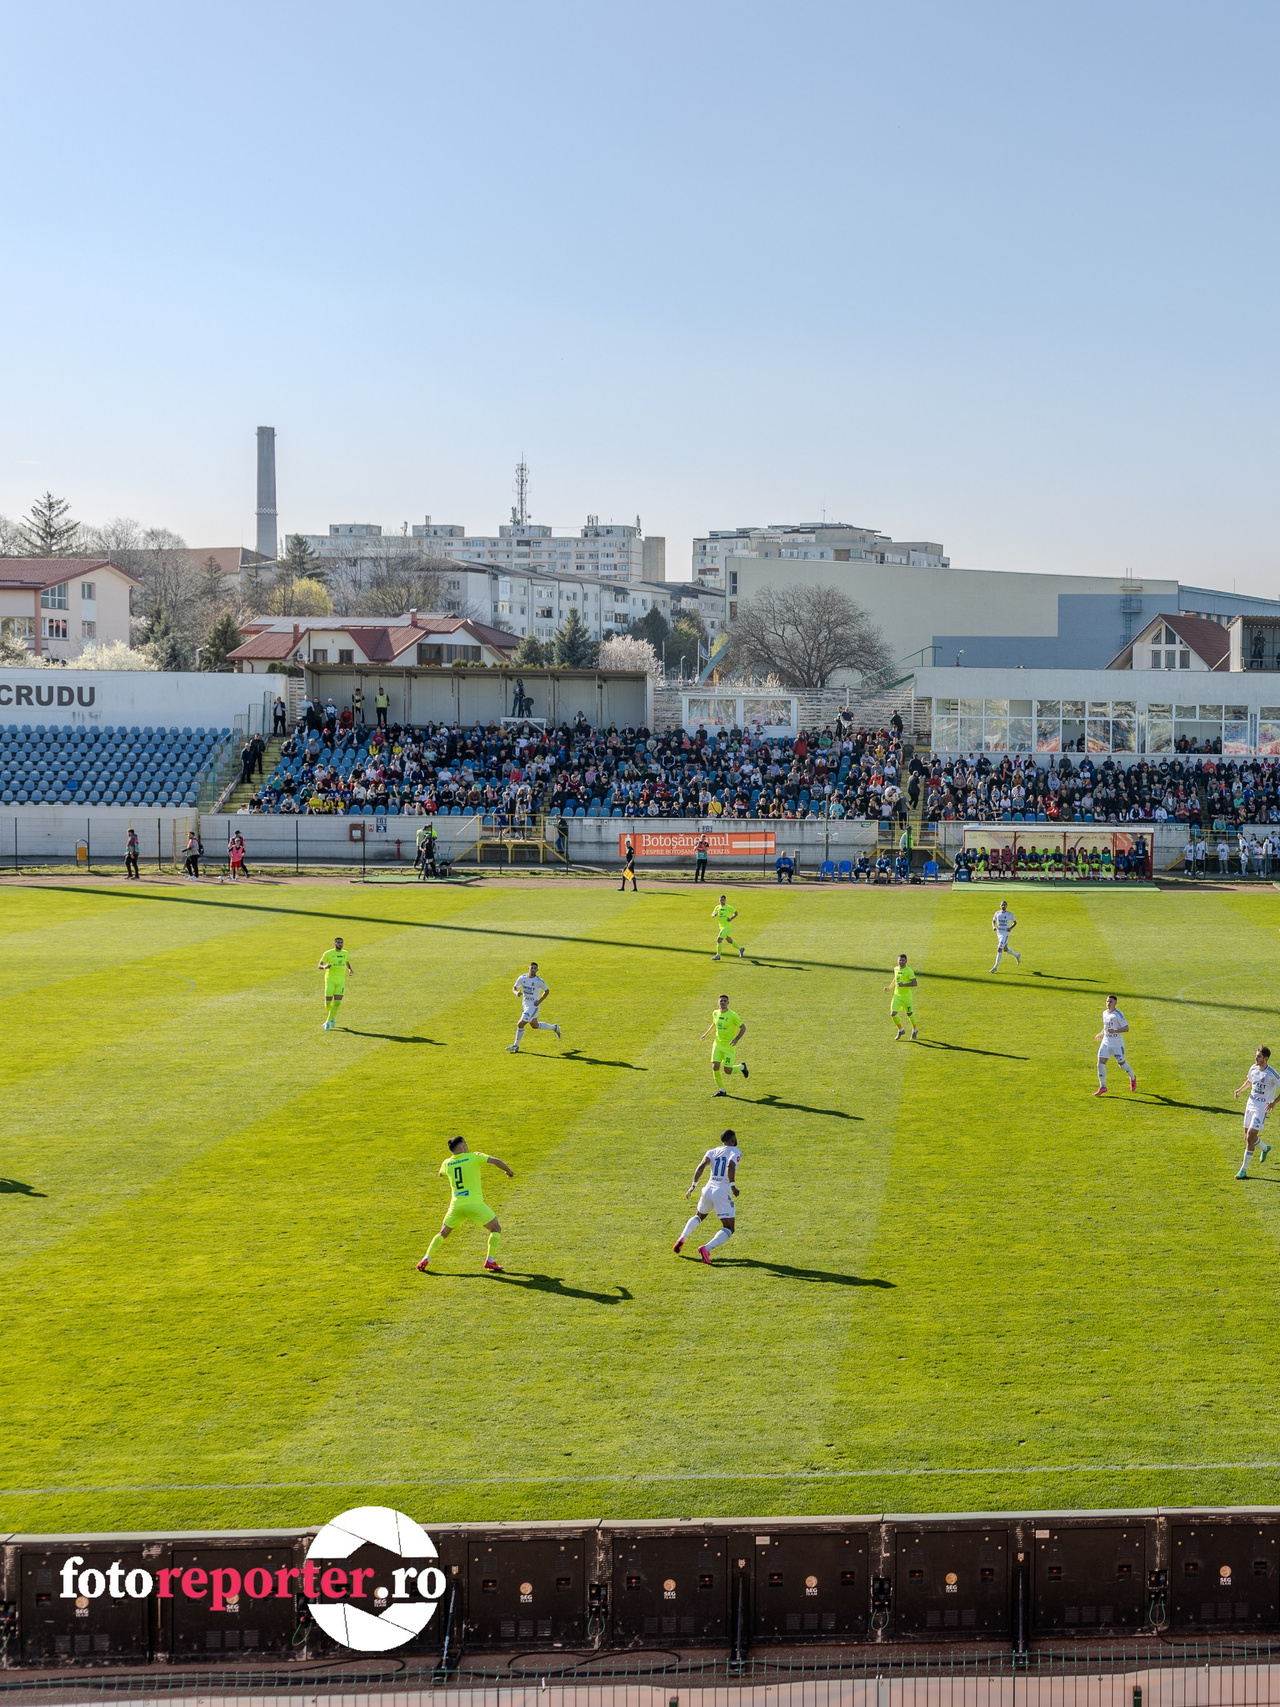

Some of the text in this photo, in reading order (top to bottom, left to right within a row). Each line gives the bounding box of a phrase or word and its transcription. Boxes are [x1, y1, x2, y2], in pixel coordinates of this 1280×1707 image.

[0, 684, 96, 707] CRUDU
[454, 1166, 464, 1190] 2
[713, 1156, 727, 1177] 11
